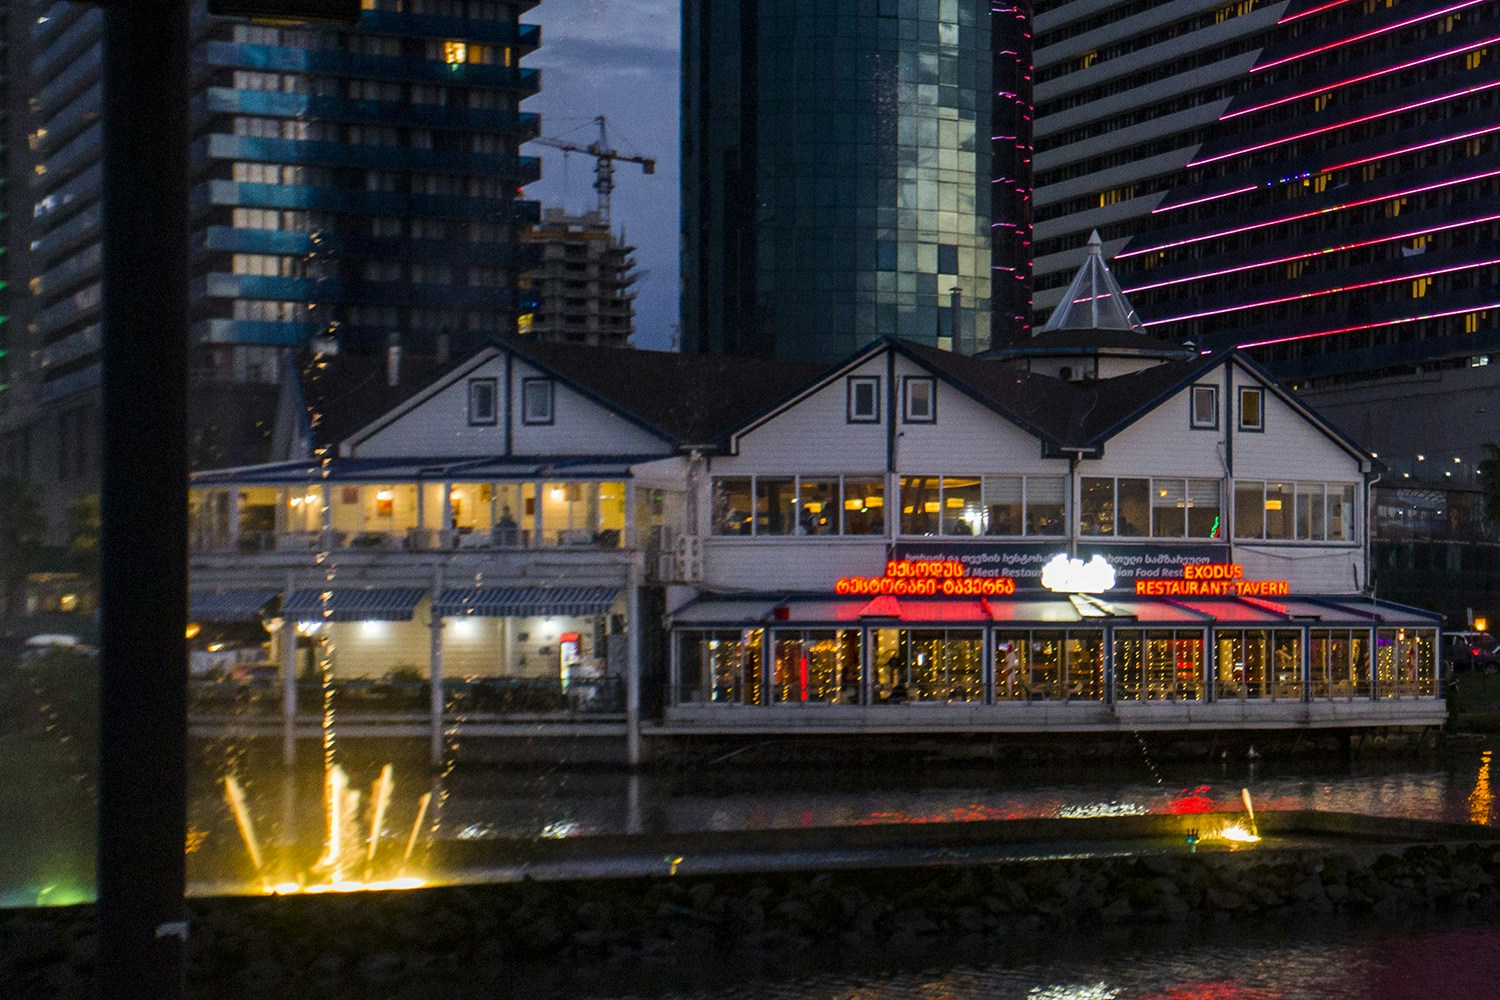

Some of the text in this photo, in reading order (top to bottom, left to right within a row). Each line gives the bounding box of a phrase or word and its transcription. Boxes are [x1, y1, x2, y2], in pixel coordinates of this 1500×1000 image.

[887, 561, 964, 577] ექსოდუს
[972, 568, 1000, 577] Meat
[1135, 567, 1160, 577] Food
[1184, 564, 1243, 579] EXODUS
[1136, 580, 1289, 595] RESTAURANT-TAVERN
